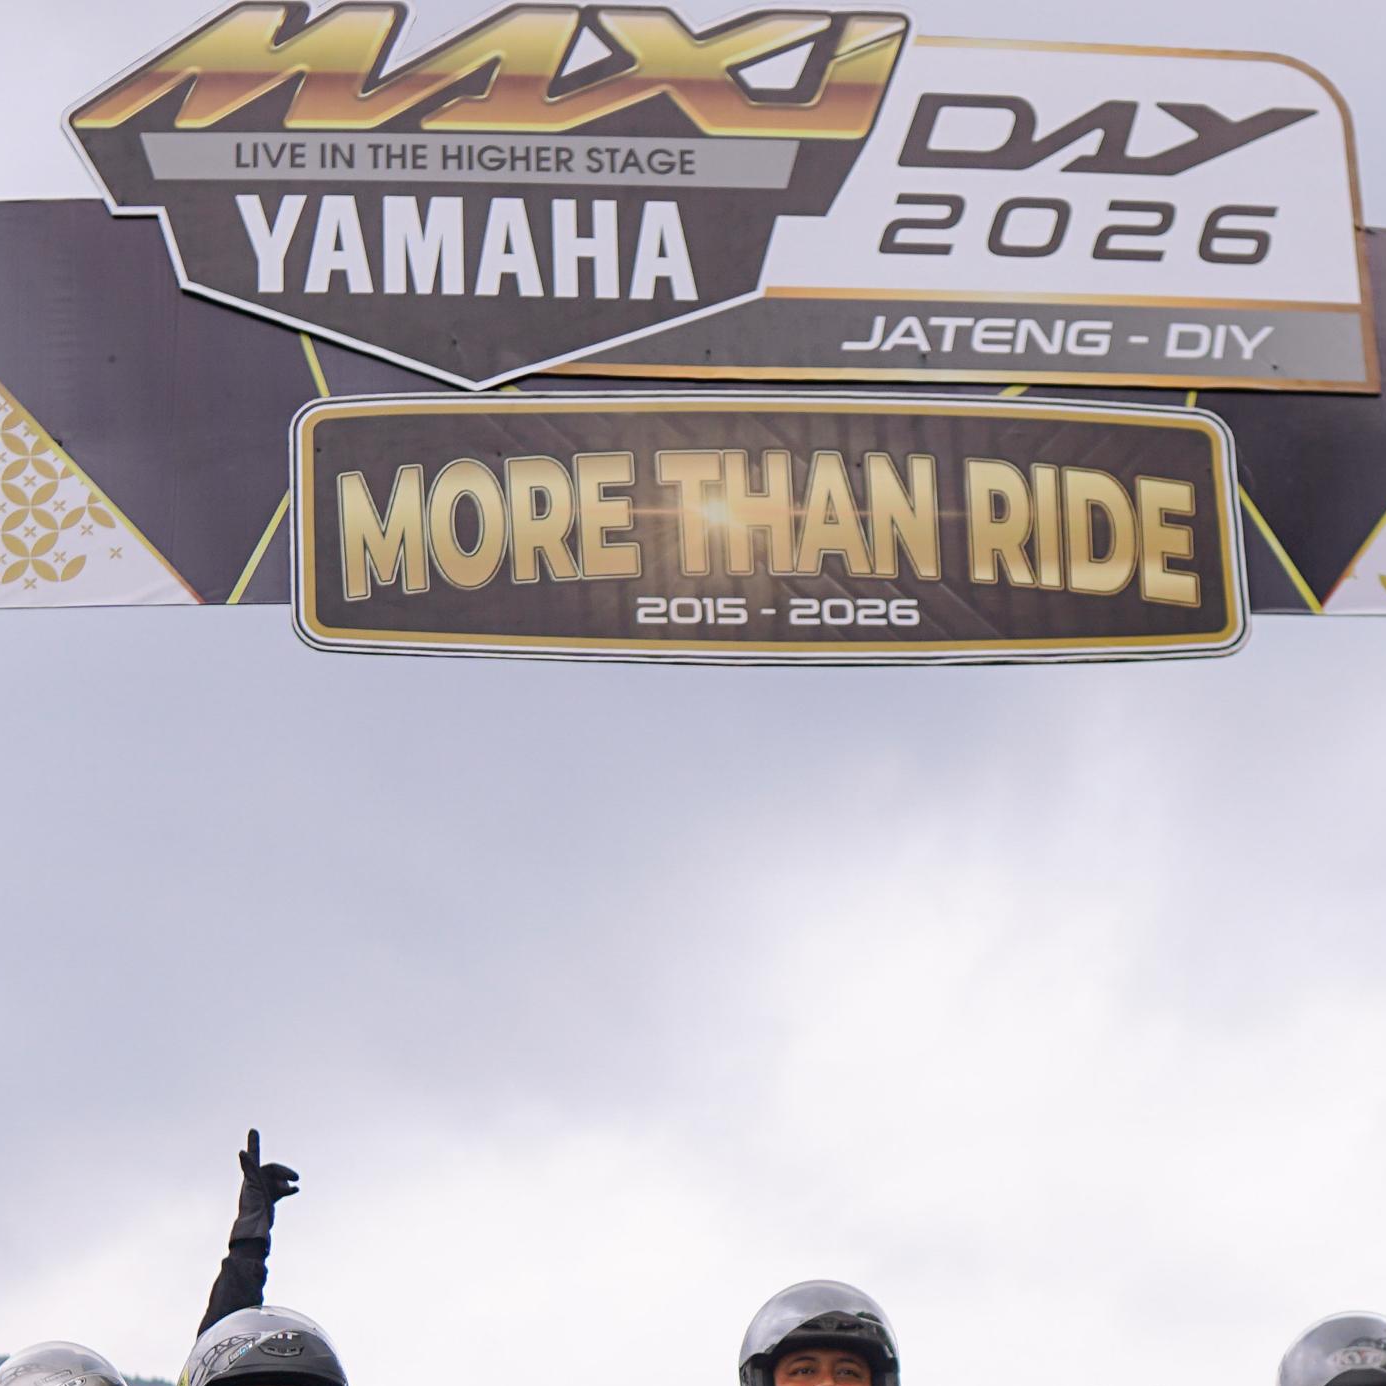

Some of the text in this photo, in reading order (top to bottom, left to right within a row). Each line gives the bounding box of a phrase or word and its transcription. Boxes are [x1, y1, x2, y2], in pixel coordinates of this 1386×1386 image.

[235, 142, 696, 176] LIVE IN THE HIGHER STAGE
[898, 93, 1318, 175] DAY
[236, 195, 698, 301] YAMAHA
[879, 193, 1278, 265] 2026
[842, 316, 1112, 356] JATENG
[1164, 323, 1275, 360] DIY
[337, 449, 1200, 606] MORE THAN RIDE
[636, 597, 749, 625] 2015
[789, 598, 919, 626] 2026
